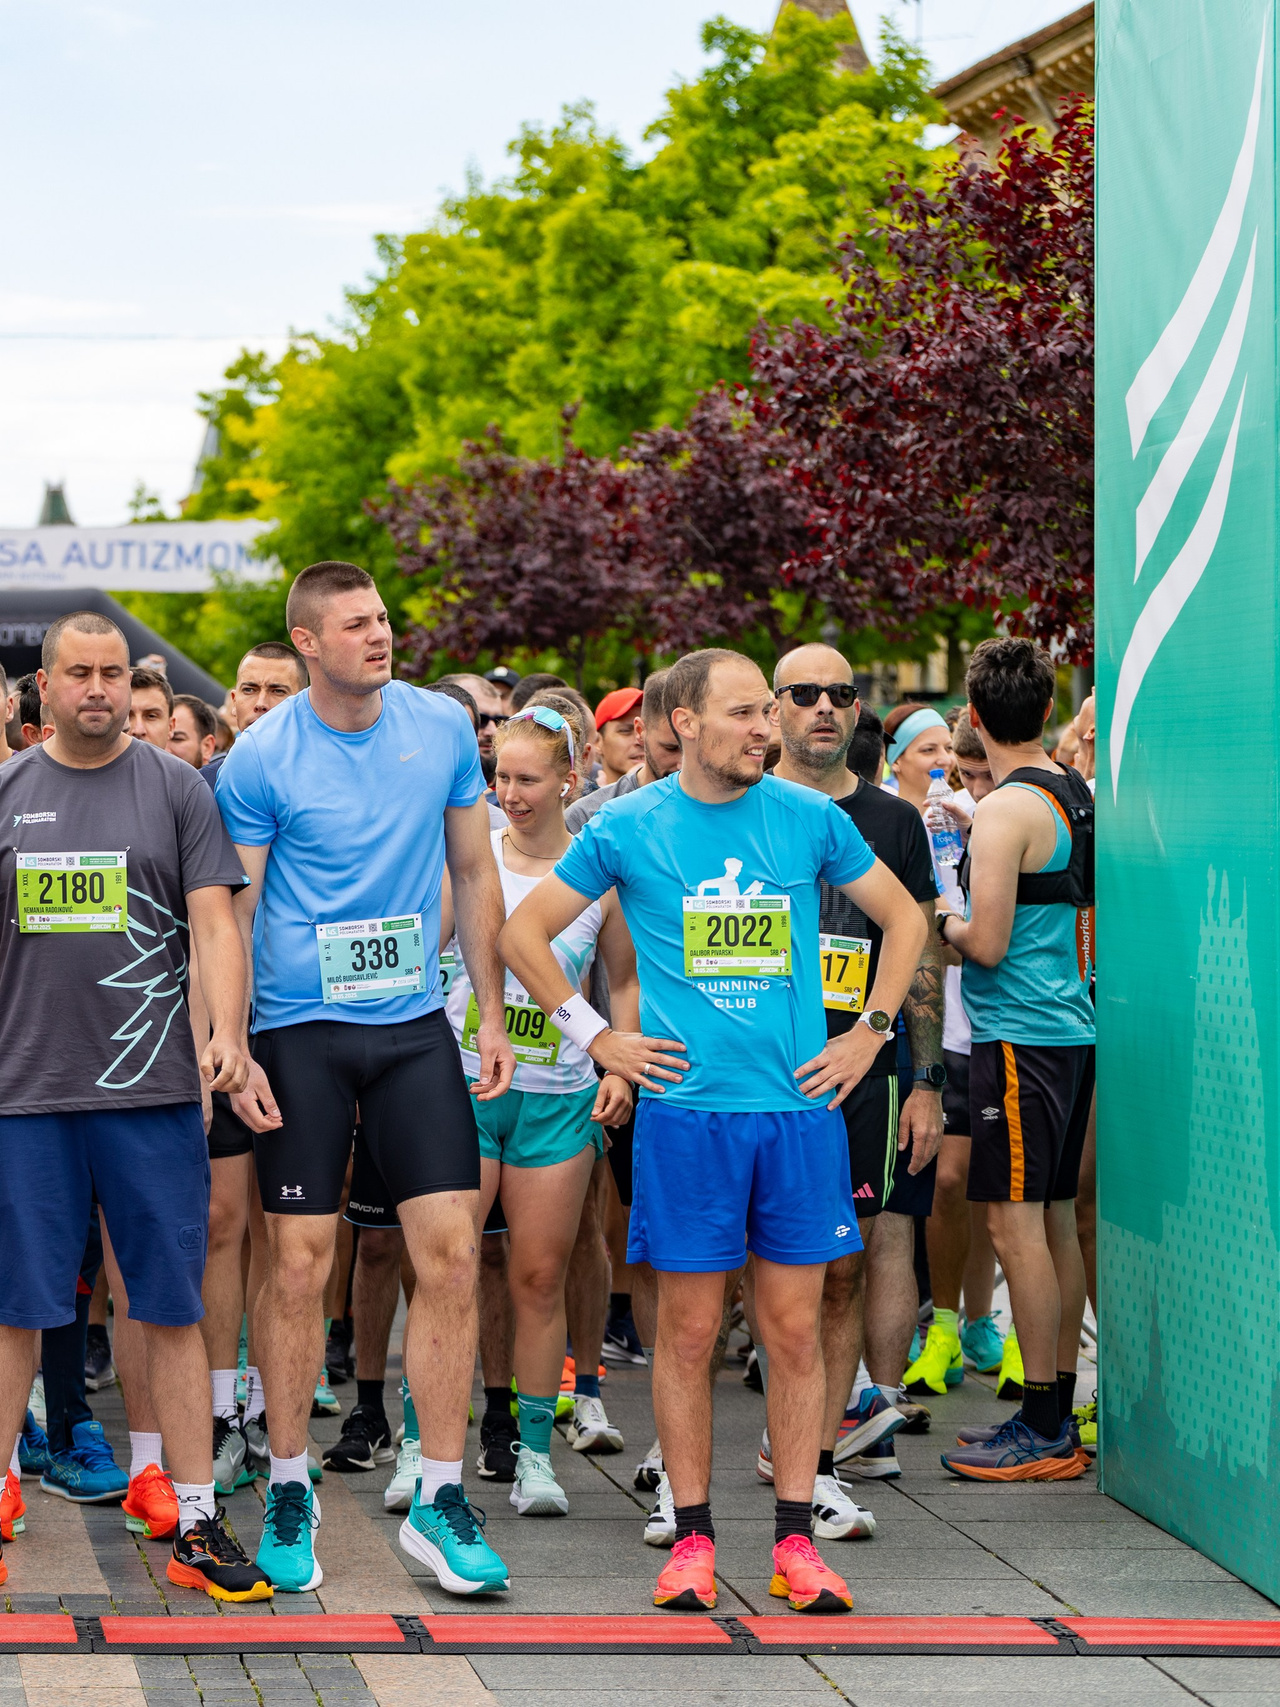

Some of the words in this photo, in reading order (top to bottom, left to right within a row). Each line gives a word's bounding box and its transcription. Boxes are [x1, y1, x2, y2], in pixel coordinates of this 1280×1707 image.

[22, 811, 57, 819] SOMBORSKI
[39, 872, 105, 904] 2180
[707, 915, 772, 947] 2022
[350, 936, 399, 972] 338
[327, 974, 343, 983] MILOŠ
[343, 972, 378, 982] BUDISAVLJEVIĆ
[823, 953, 849, 983] 17
[697, 980, 770, 992] RUNNING
[714, 998, 757, 1009] CLUB
[505, 1006, 545, 1039] 009
[349, 1201, 384, 1214] GIVOVA
